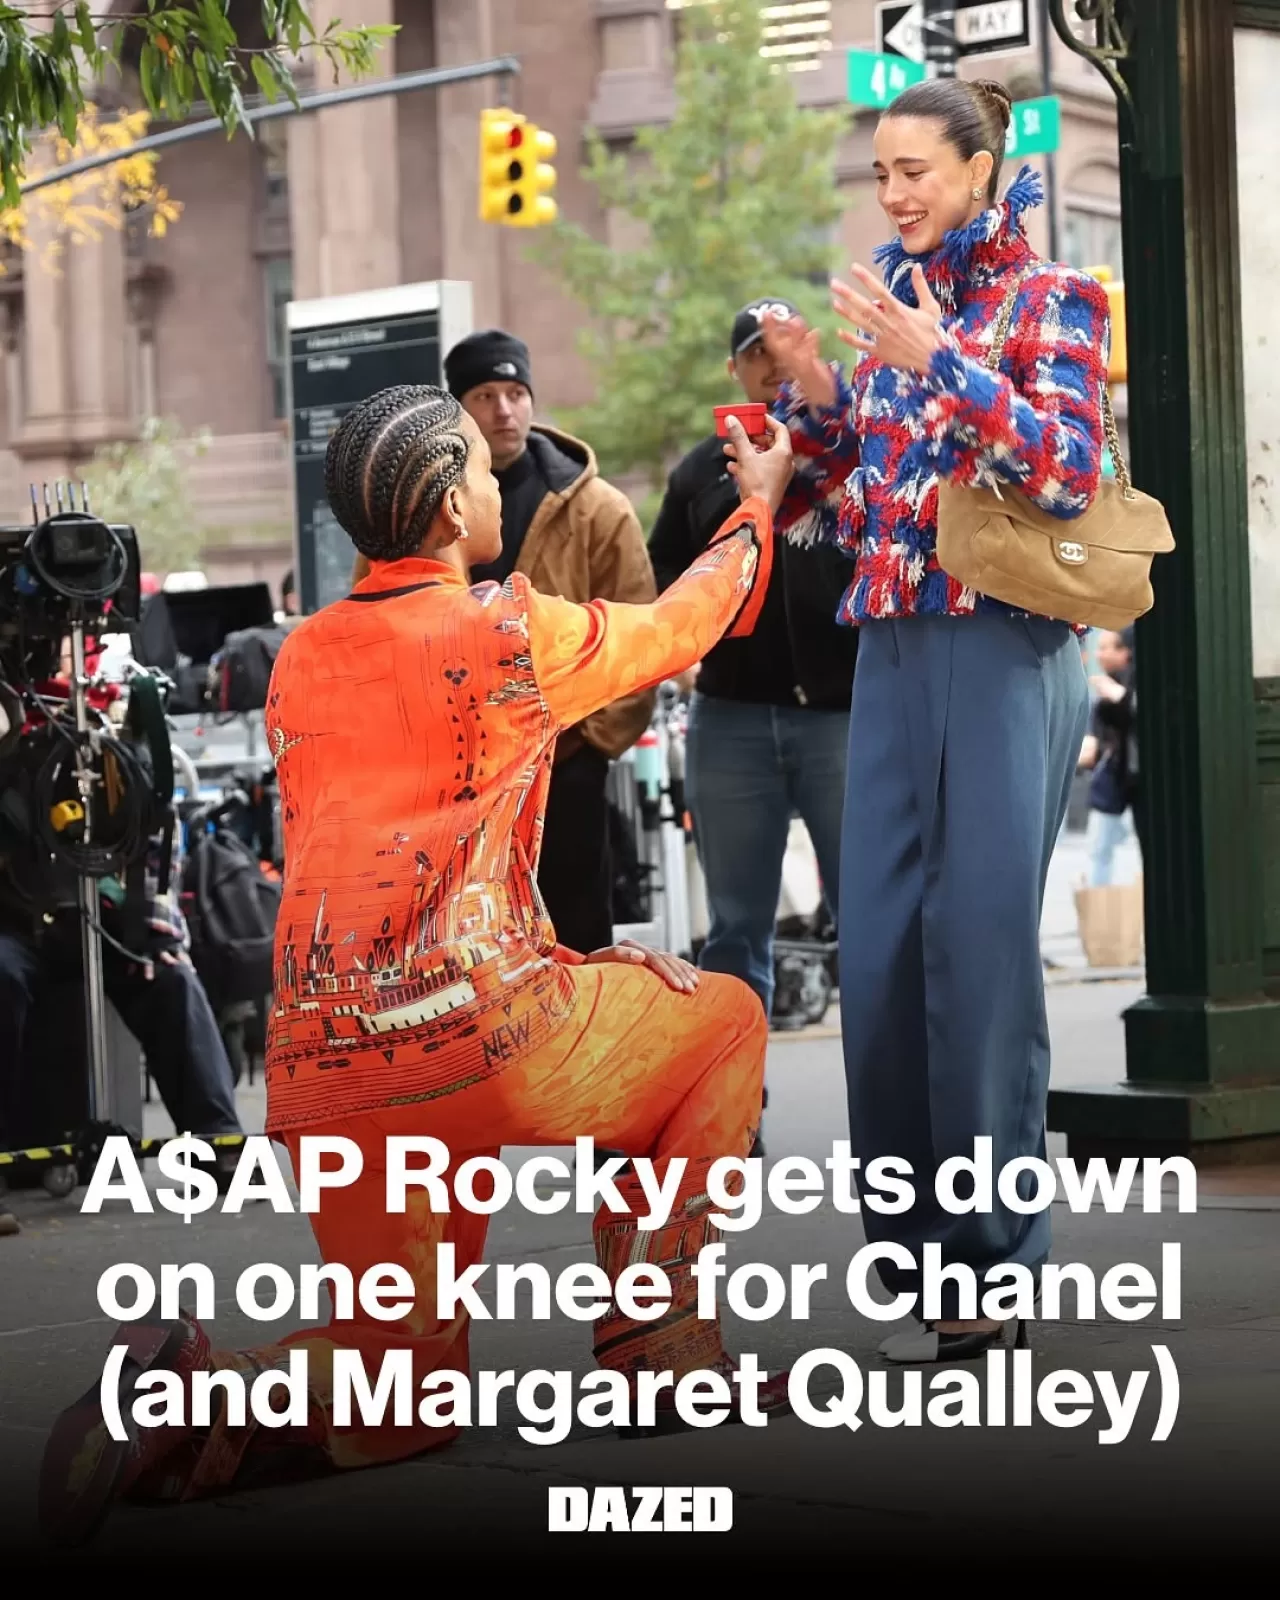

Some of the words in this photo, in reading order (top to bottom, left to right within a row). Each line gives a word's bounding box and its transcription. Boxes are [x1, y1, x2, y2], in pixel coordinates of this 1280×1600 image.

[966, 8, 1010, 35] WAY
[870, 59, 886, 101] 4
[481, 1010, 530, 1068] NEW
